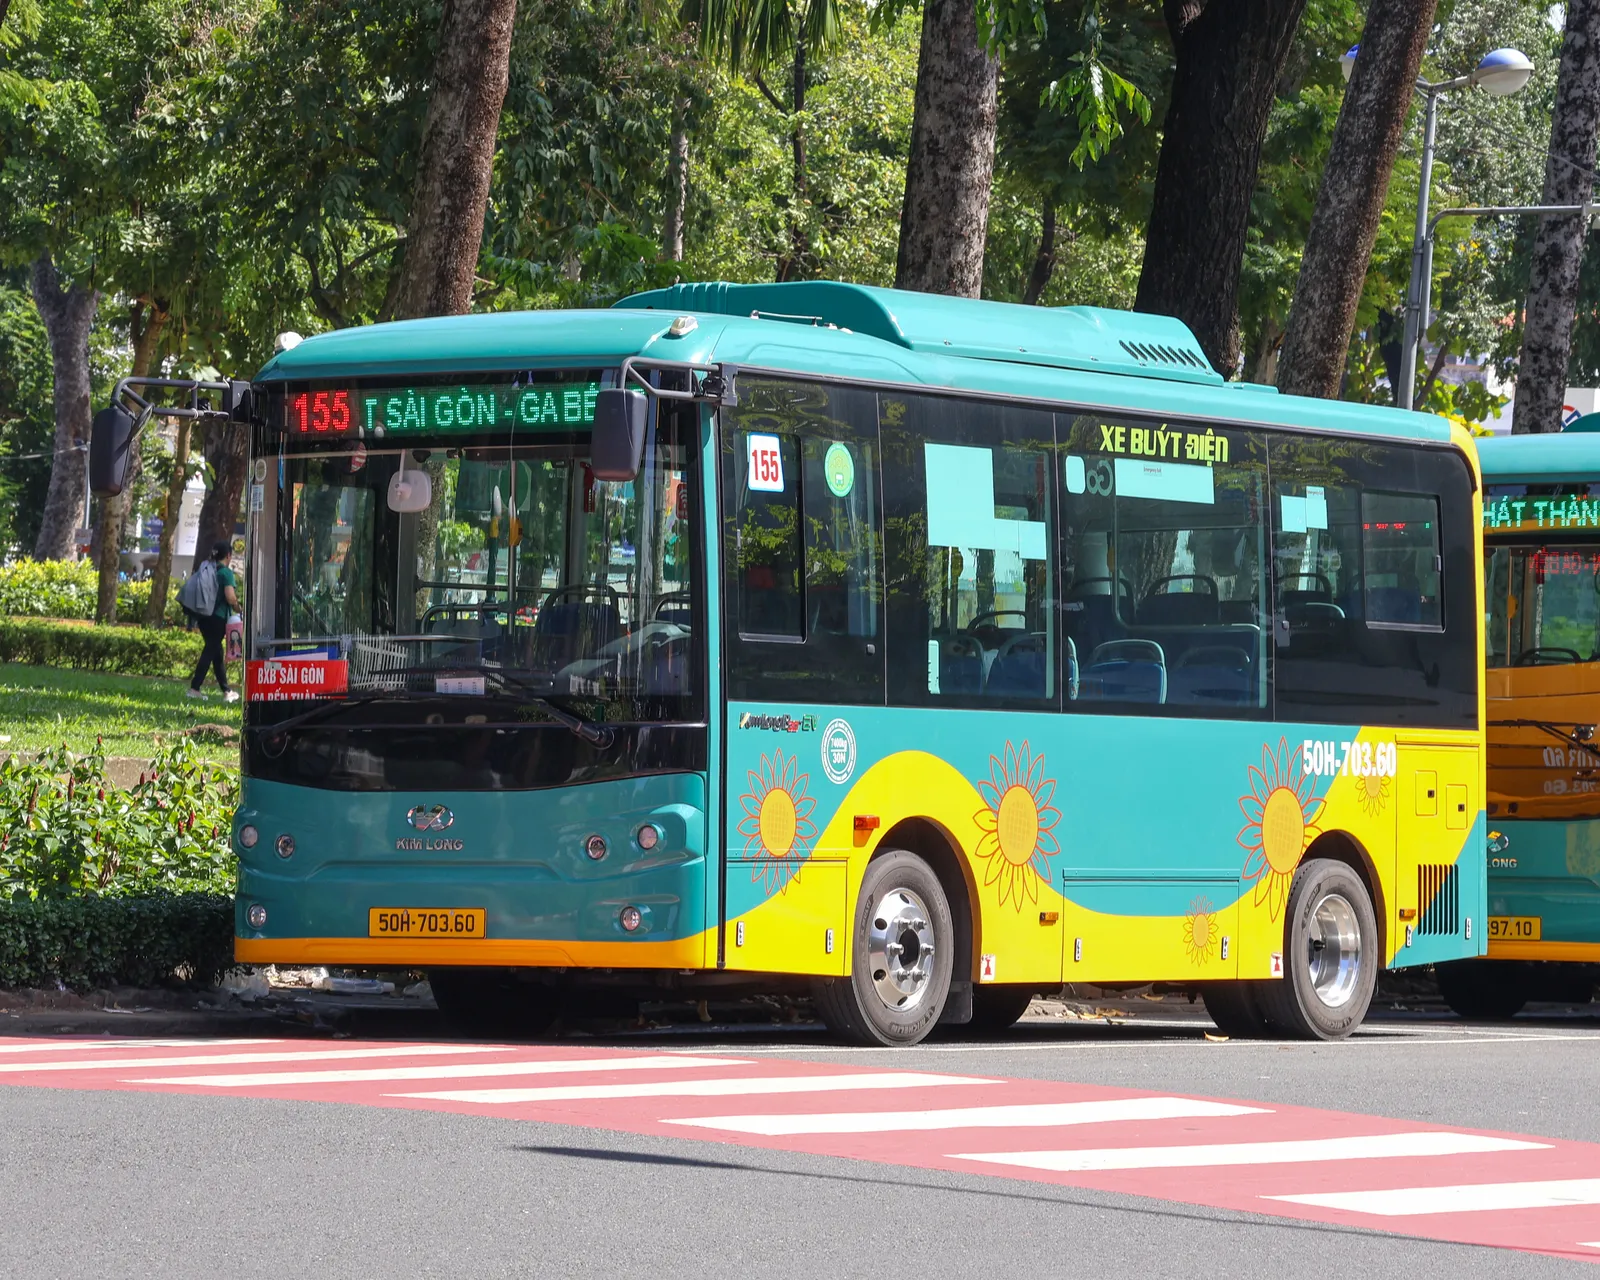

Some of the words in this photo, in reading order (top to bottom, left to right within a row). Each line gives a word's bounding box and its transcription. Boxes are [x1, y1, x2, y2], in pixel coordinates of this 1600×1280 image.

[295, 392, 350, 431] 155
[387, 389, 426, 428] SÀI
[434, 387, 495, 426] GÒN
[520, 392, 558, 423] GA
[564, 382, 600, 422] BẾ
[1100, 424, 1126, 453] XE
[1130, 423, 1183, 458] BUÝT
[1184, 428, 1229, 467] ĐIỆN
[752, 449, 779, 482] 155
[279, 664, 298, 684] SÀI
[300, 663, 325, 684] GÒN
[1303, 739, 1397, 777] 50H-703.60
[396, 838, 423, 850] KIM
[425, 838, 464, 851] LONG
[378, 912, 476, 933] 50H-703.60
[1487, 920, 1533, 937] 97.10
